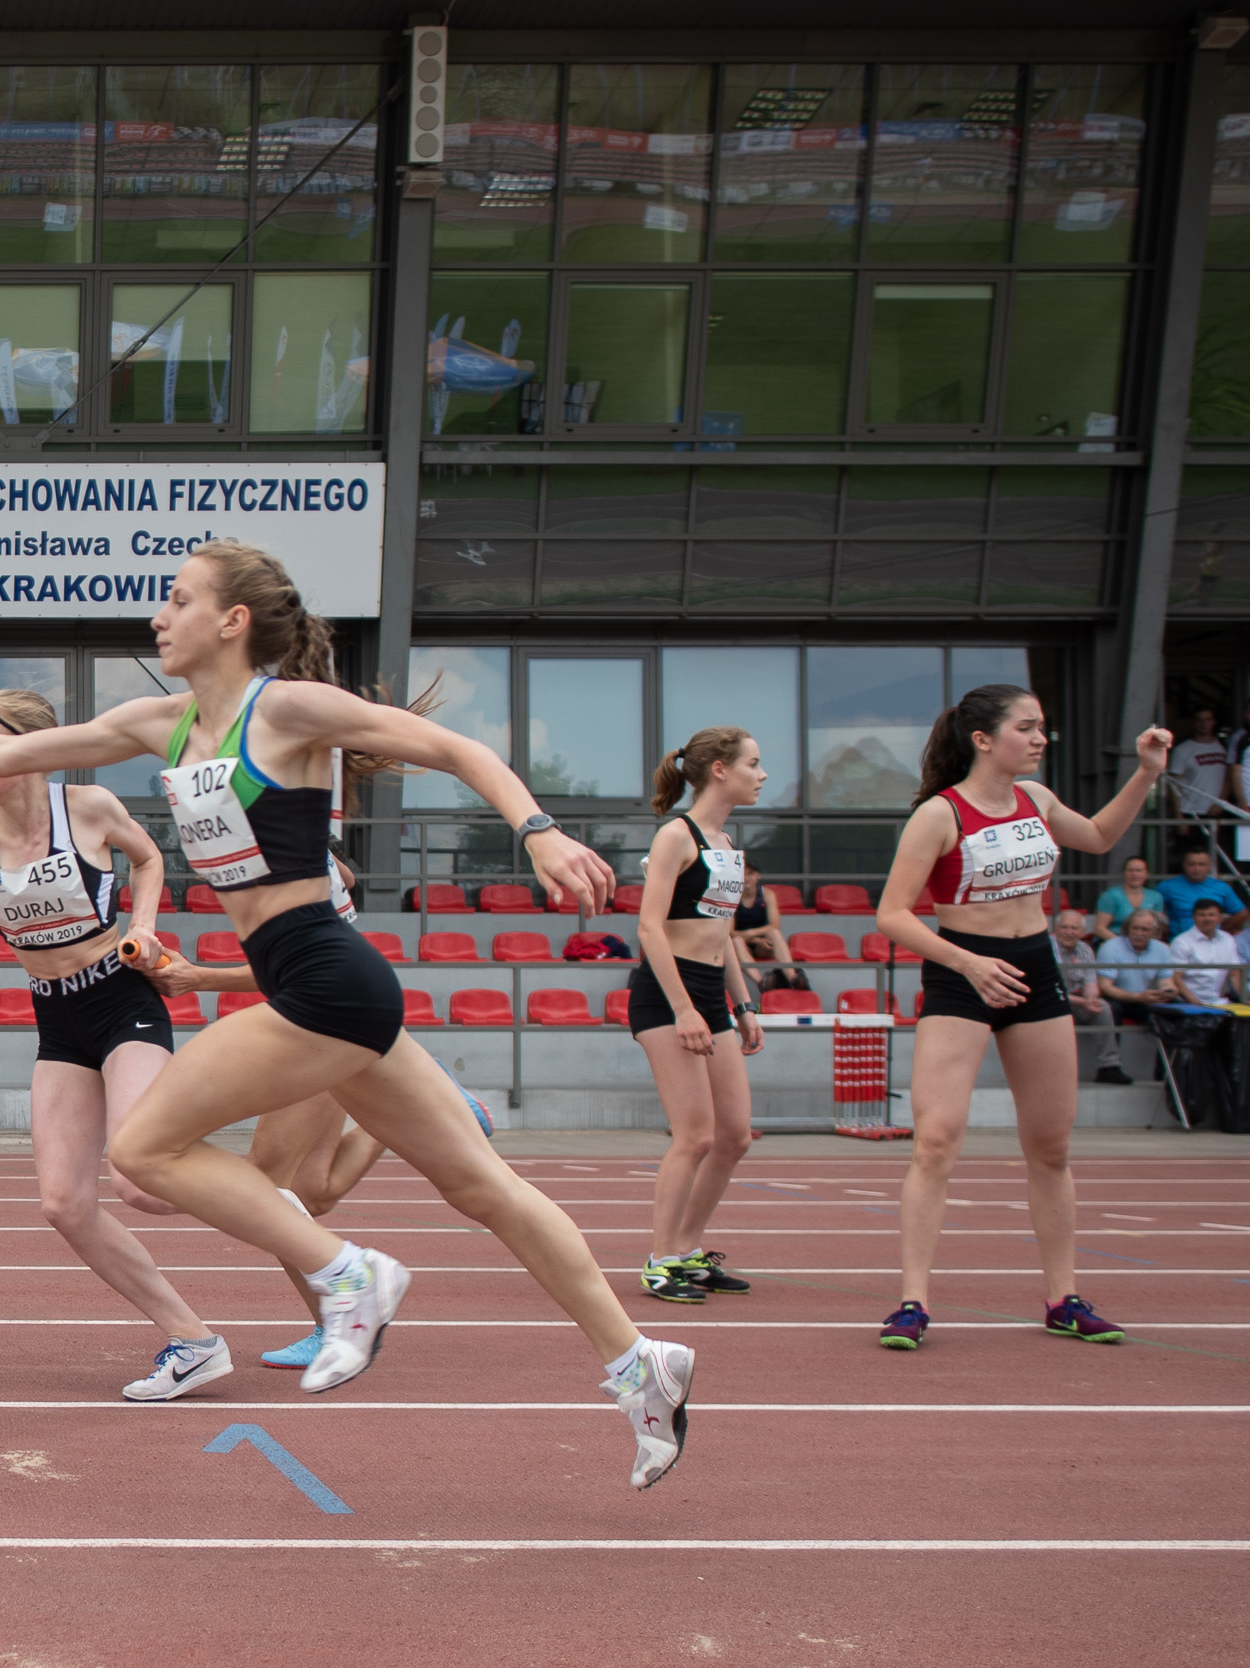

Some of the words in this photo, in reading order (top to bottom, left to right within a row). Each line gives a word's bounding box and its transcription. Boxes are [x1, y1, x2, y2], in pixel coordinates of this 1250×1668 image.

[169, 478, 369, 512] FIZYCZNEGO
[191, 763, 227, 798] 102
[1012, 821, 1045, 841] 325
[27, 857, 72, 886] 455
[983, 846, 1055, 878] GRUDZIEŃ
[4, 898, 65, 922] DURAJ
[57, 925, 83, 940] 2019
[60, 950, 122, 996] NIKE
